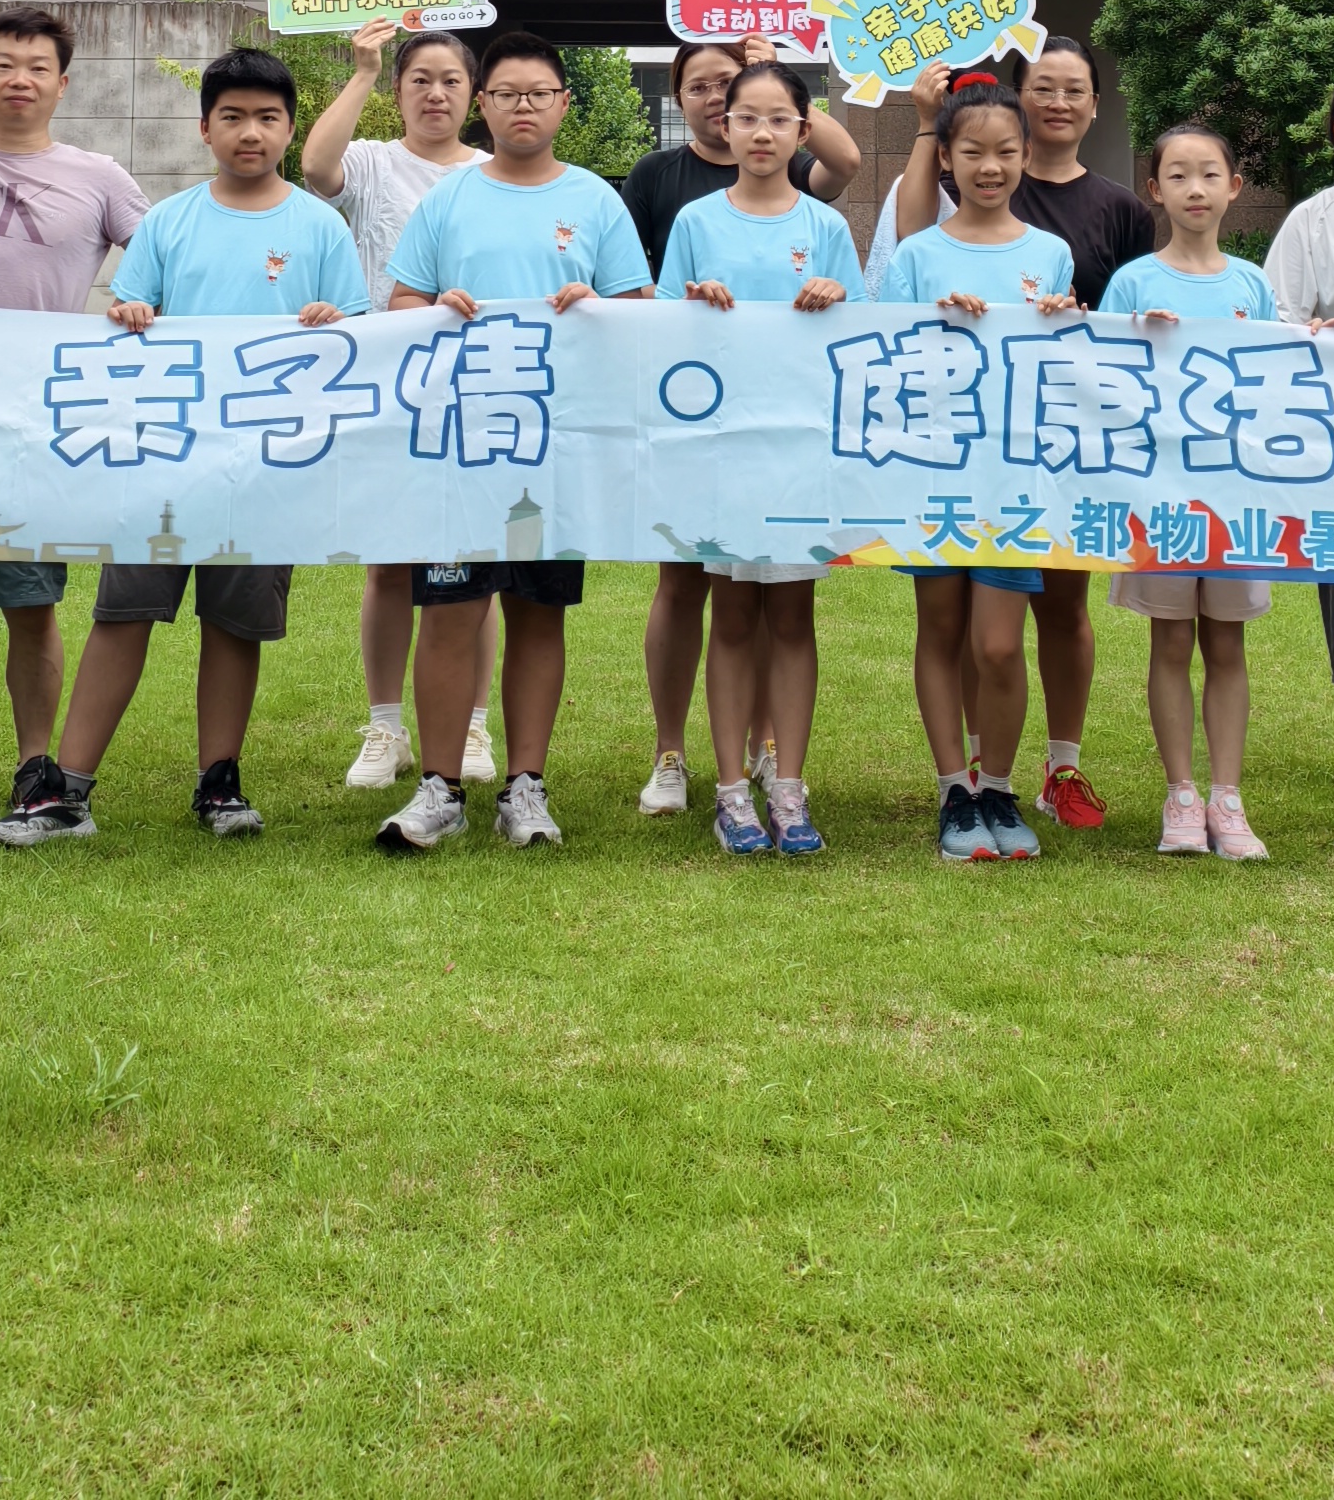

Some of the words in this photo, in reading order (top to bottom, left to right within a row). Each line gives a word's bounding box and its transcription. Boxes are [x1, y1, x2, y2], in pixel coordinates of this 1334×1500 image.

[422, 13, 438, 22] GO
[441, 12, 456, 21] GO
[458, 11, 474, 20] GO
[702, 6, 812, 32] 运动到底
[43, 313, 555, 468] 亲子情
[427, 569, 467, 584] NASA
